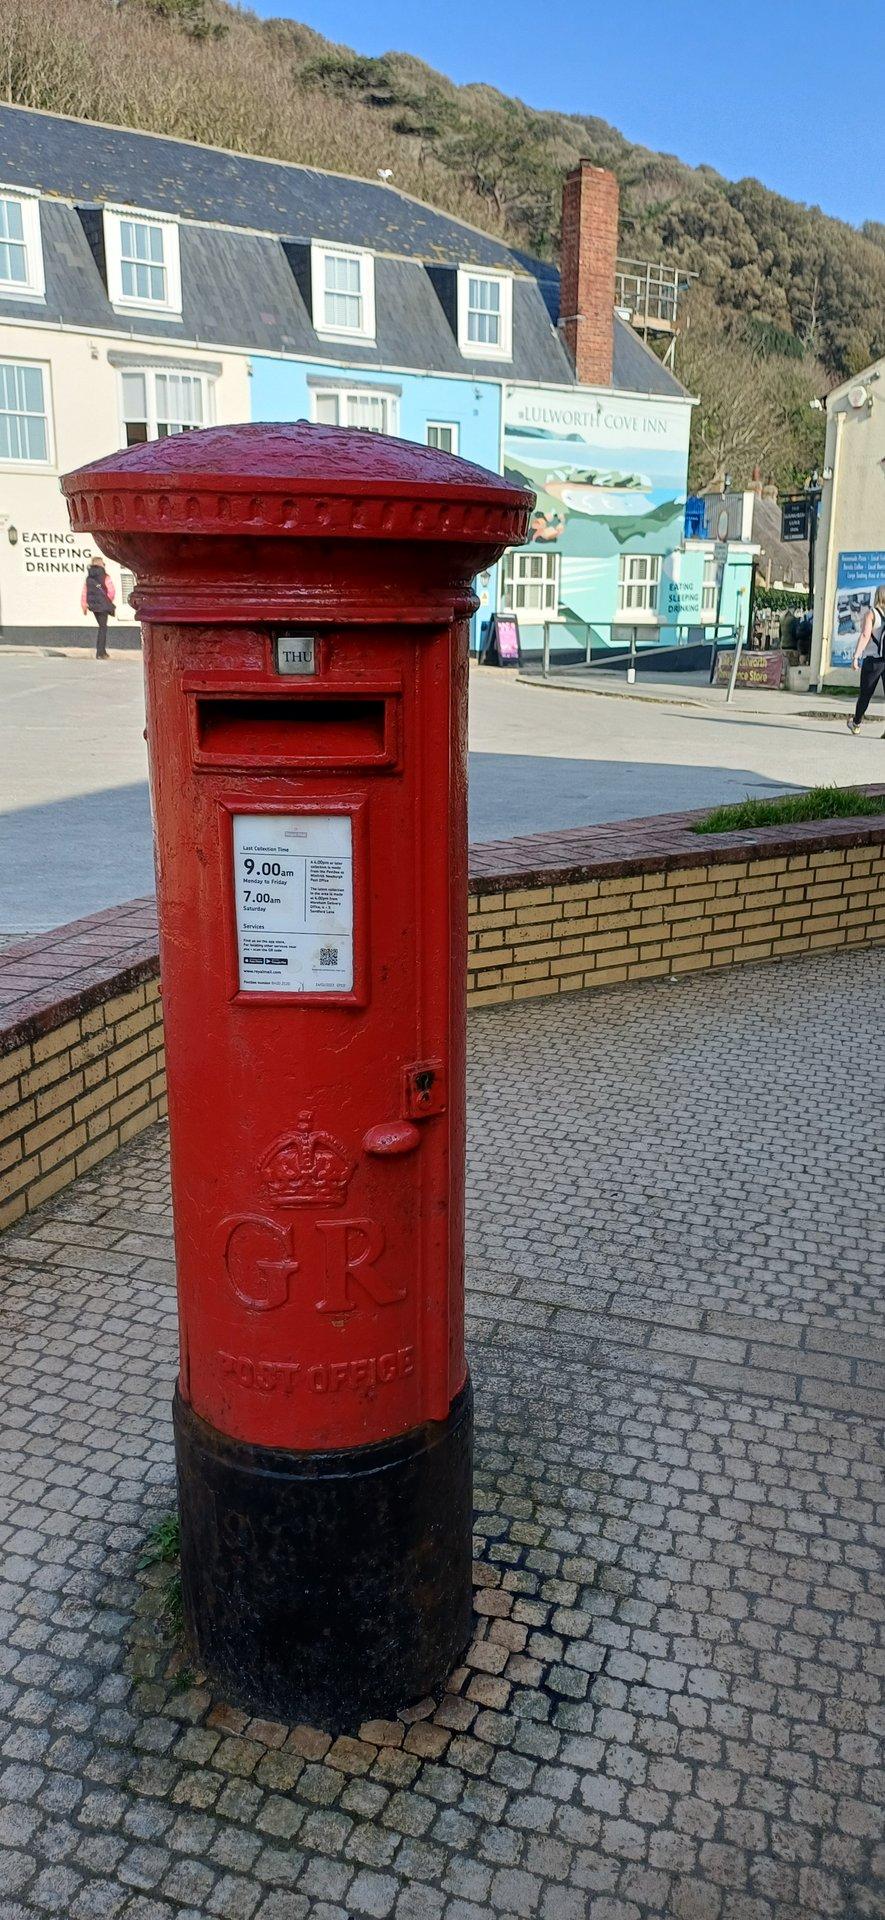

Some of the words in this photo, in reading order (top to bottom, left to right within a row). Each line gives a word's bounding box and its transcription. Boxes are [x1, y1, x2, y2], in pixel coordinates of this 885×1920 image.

[524, 406, 600, 427] LULWORTH
[604, 414, 637, 431] COVE
[642, 418, 667, 433] INN
[22, 532, 75, 544] EATING
[24, 547, 92, 559] SLEEPING
[26, 562, 90, 573] DRINKIN
[669, 583, 694, 592] EATING
[668, 593, 699, 603] SLEEPING
[668, 604, 699, 613] DRINKING
[282, 651, 313, 663] THU
[749, 670, 768, 682] Store
[243, 858, 294, 877] 9.00am
[243, 890, 281, 904] 7.00am
[307, 1344, 415, 1393] OFFICE
